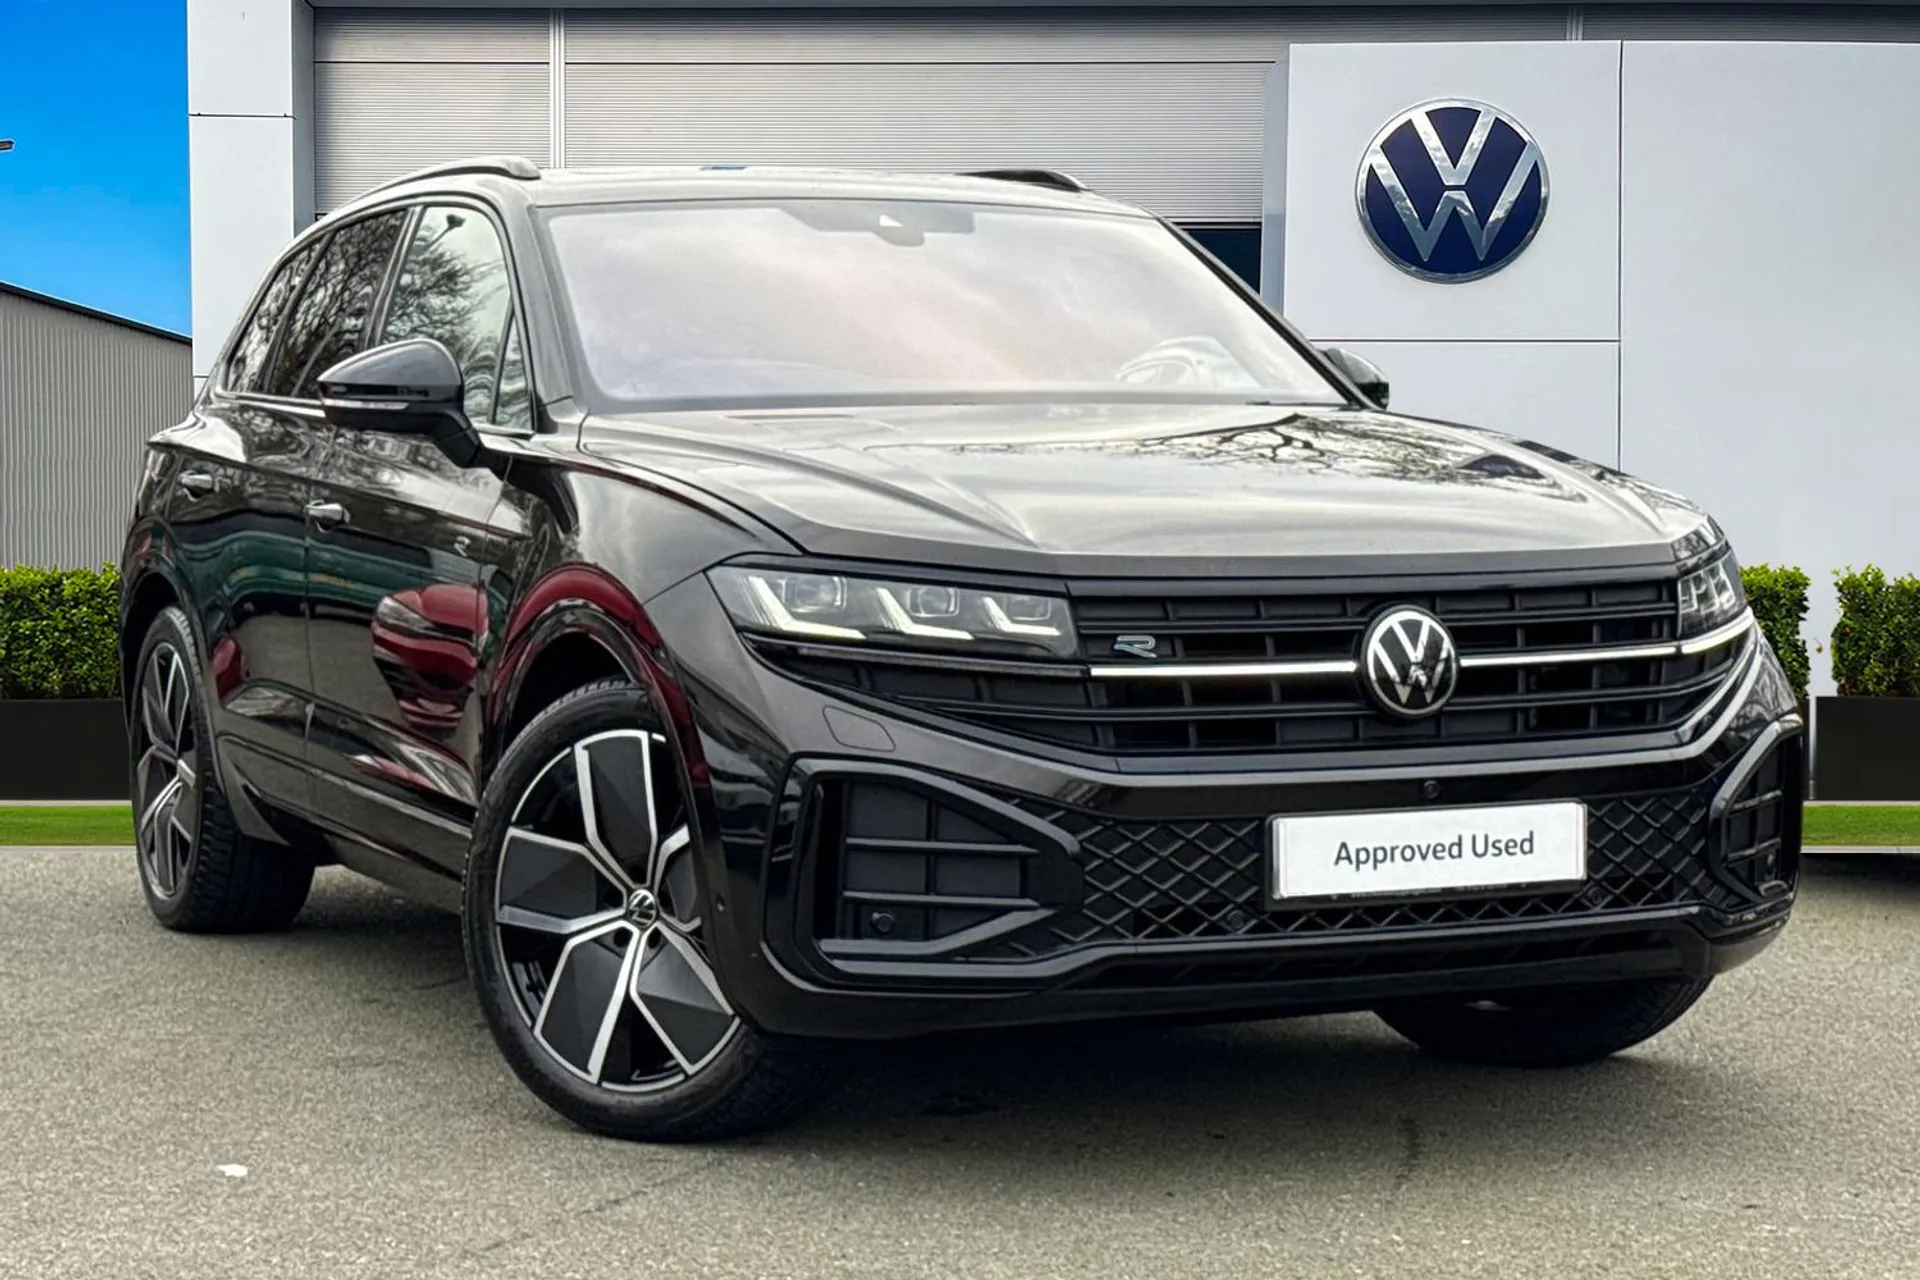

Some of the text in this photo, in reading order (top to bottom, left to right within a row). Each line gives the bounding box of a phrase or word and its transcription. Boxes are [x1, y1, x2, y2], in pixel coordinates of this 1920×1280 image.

[1359, 101, 1546, 268] VW
[1113, 634, 1158, 658] R
[1367, 609, 1455, 710] VW
[1334, 831, 1534, 871] Approved Used
